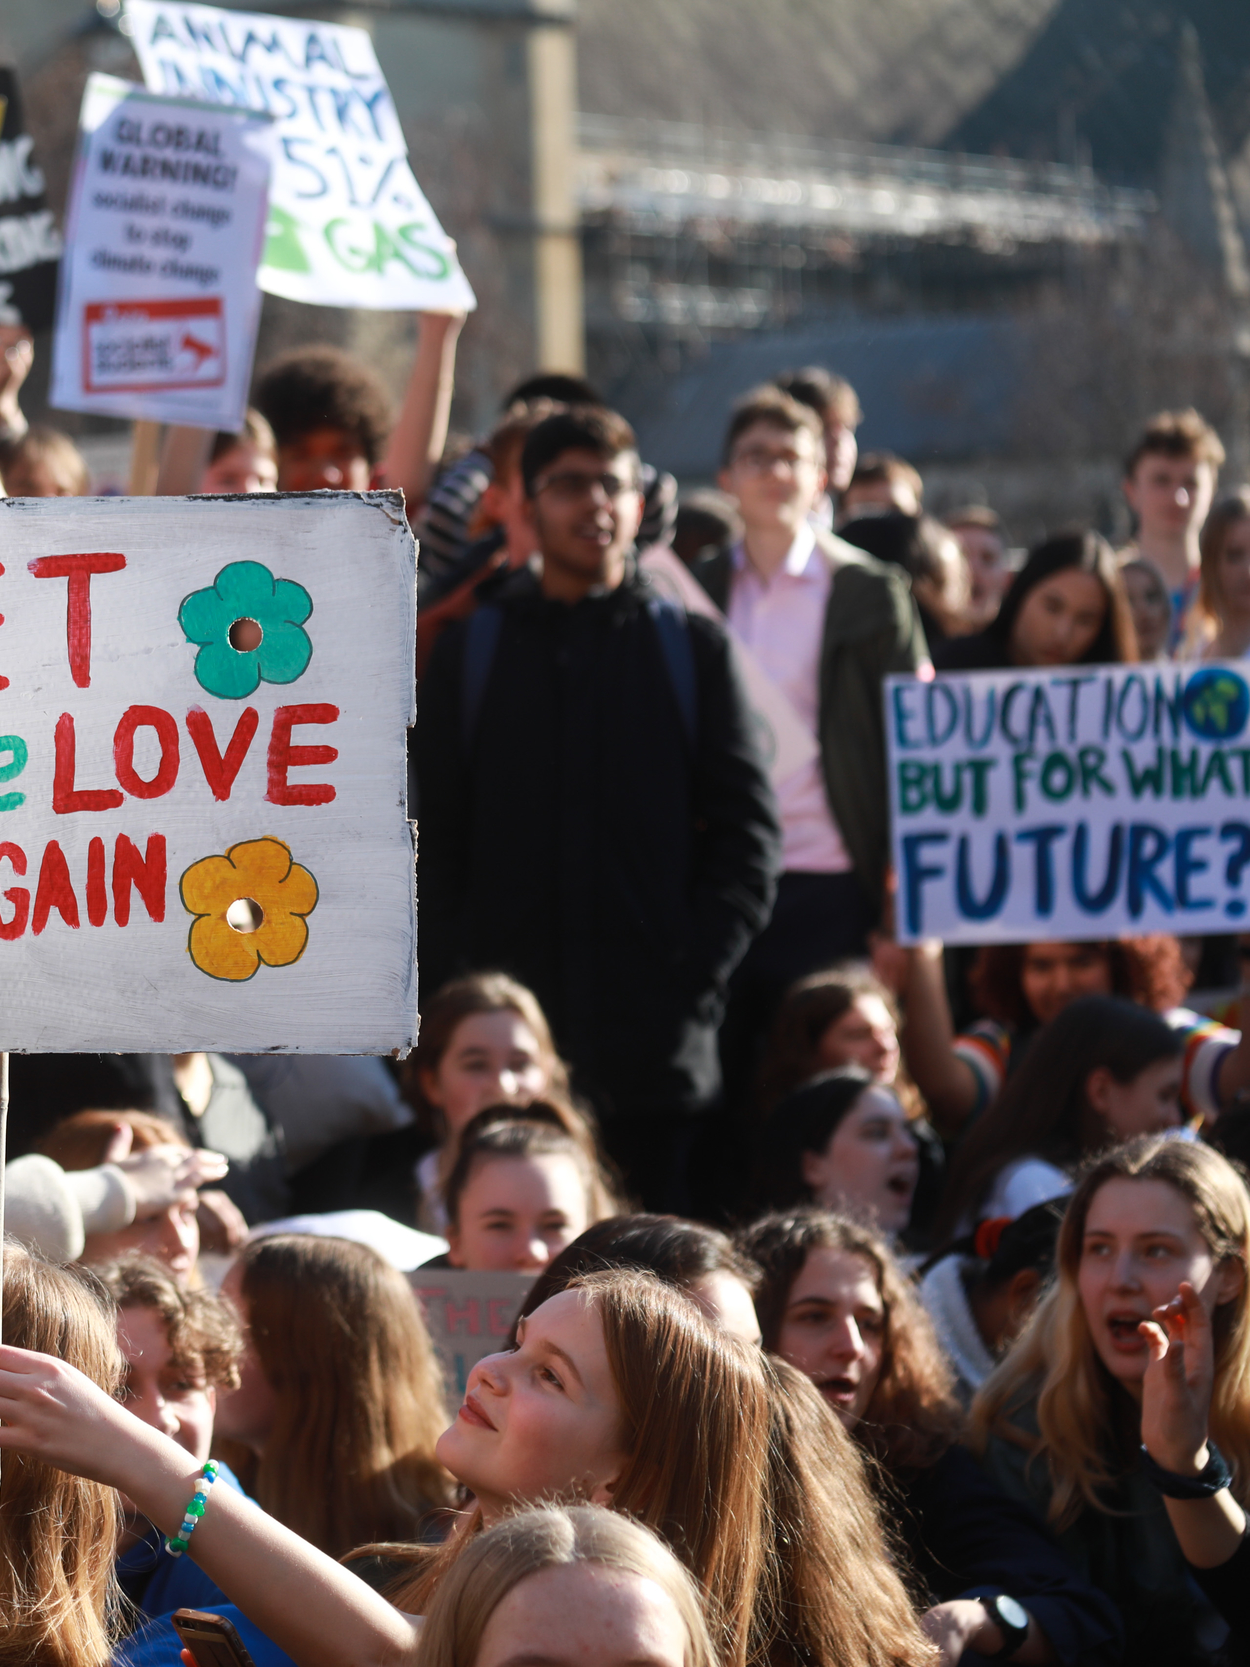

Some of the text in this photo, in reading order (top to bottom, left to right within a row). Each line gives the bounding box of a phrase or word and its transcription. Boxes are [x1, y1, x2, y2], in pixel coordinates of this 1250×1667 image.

[150, 14, 370, 80] ANIMAL
[116, 117, 222, 156] GLOBAL
[100, 150, 237, 192] WARNING!
[125, 222, 191, 252] to stop
[171, 199, 232, 230] change
[91, 248, 221, 287] climate change
[324, 217, 450, 282] GAS
[893, 673, 1183, 749] EDUCATION
[52, 704, 340, 814] LOVE
[898, 745, 1250, 820] BUT FOR WHAT
[901, 819, 1250, 937] FUTURE?
